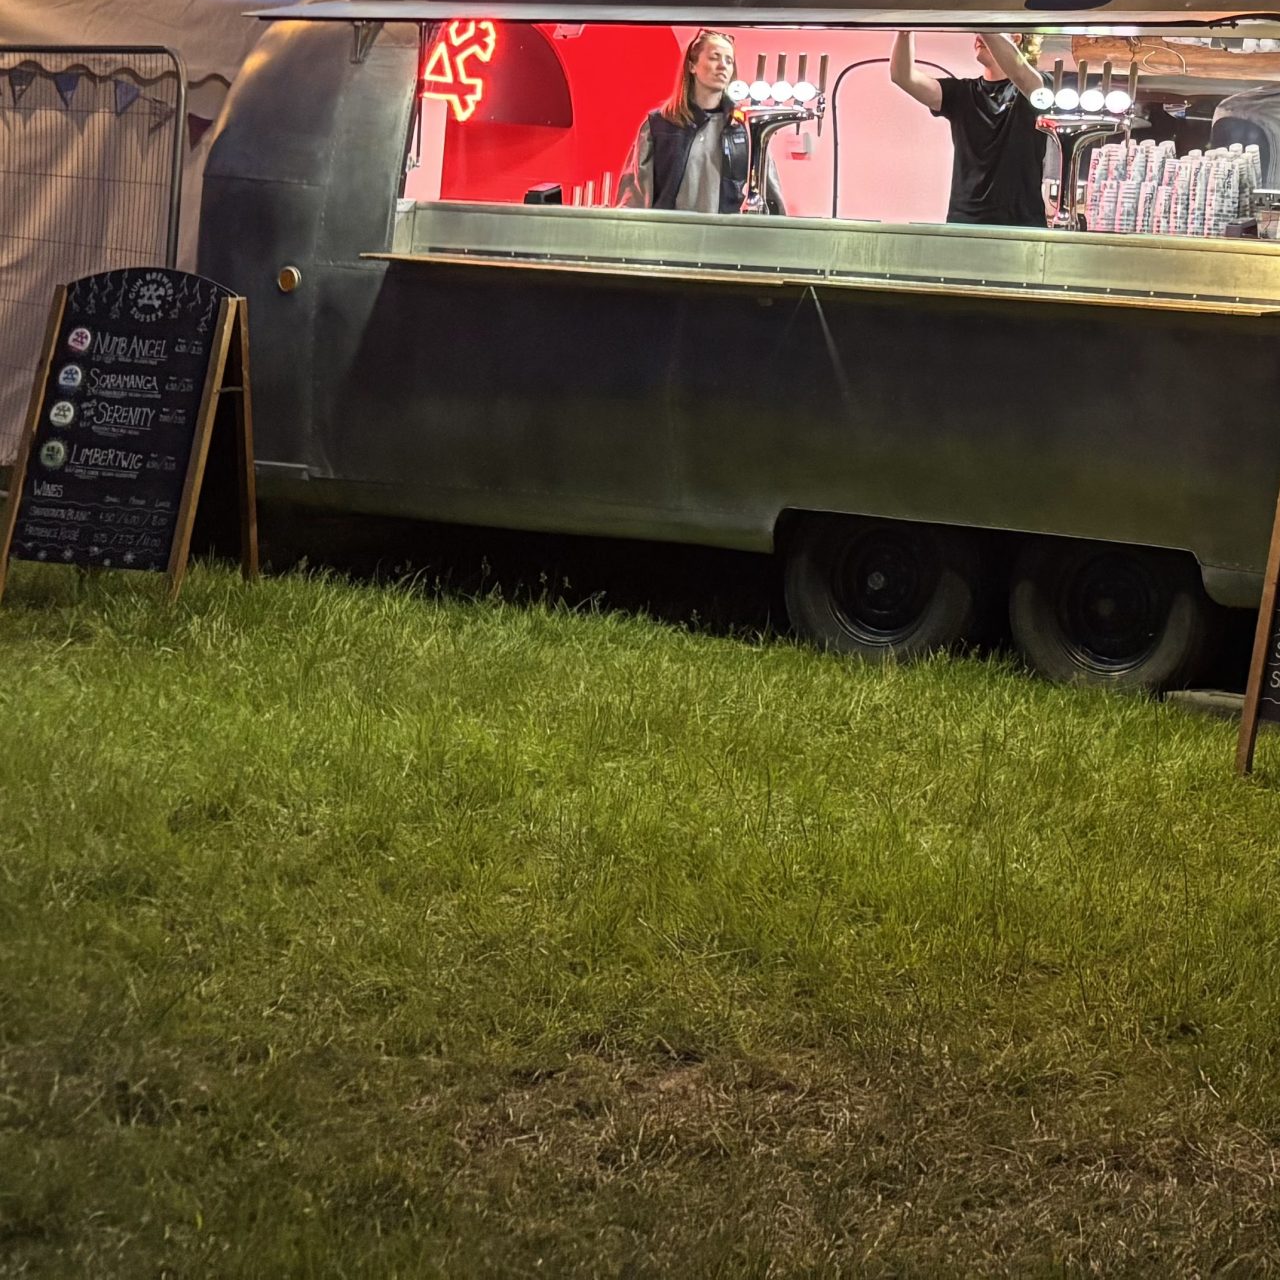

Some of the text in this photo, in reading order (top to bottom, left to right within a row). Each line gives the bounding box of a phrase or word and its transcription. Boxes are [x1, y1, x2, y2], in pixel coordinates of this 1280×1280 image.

[145, 272, 174, 302] BREWERY
[87, 367, 159, 391] SCARAMANGA
[93, 401, 156, 427] SERENITY
[69, 444, 144, 470] LIMBERTWIG
